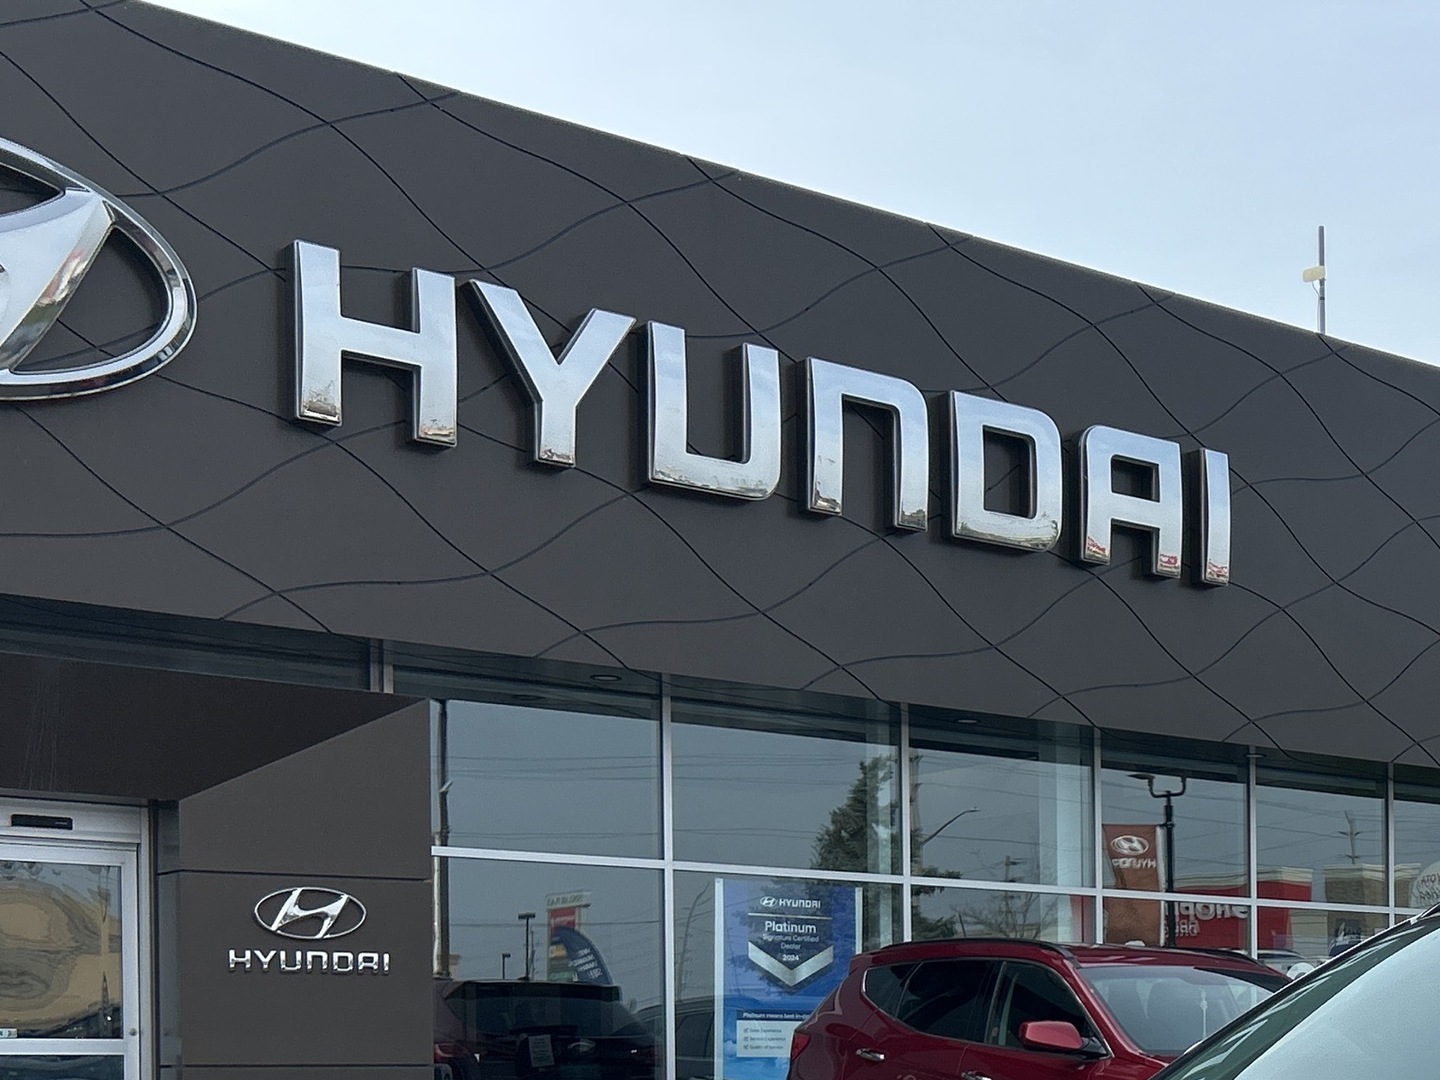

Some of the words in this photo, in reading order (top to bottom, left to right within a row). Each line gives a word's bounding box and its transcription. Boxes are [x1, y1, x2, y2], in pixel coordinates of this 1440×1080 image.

[288, 239, 1231, 587] HYUNDAI
[778, 898, 821, 909] HYUNDAI
[764, 920, 817, 934] Platinum
[228, 949, 390, 974] HYUNDAI
